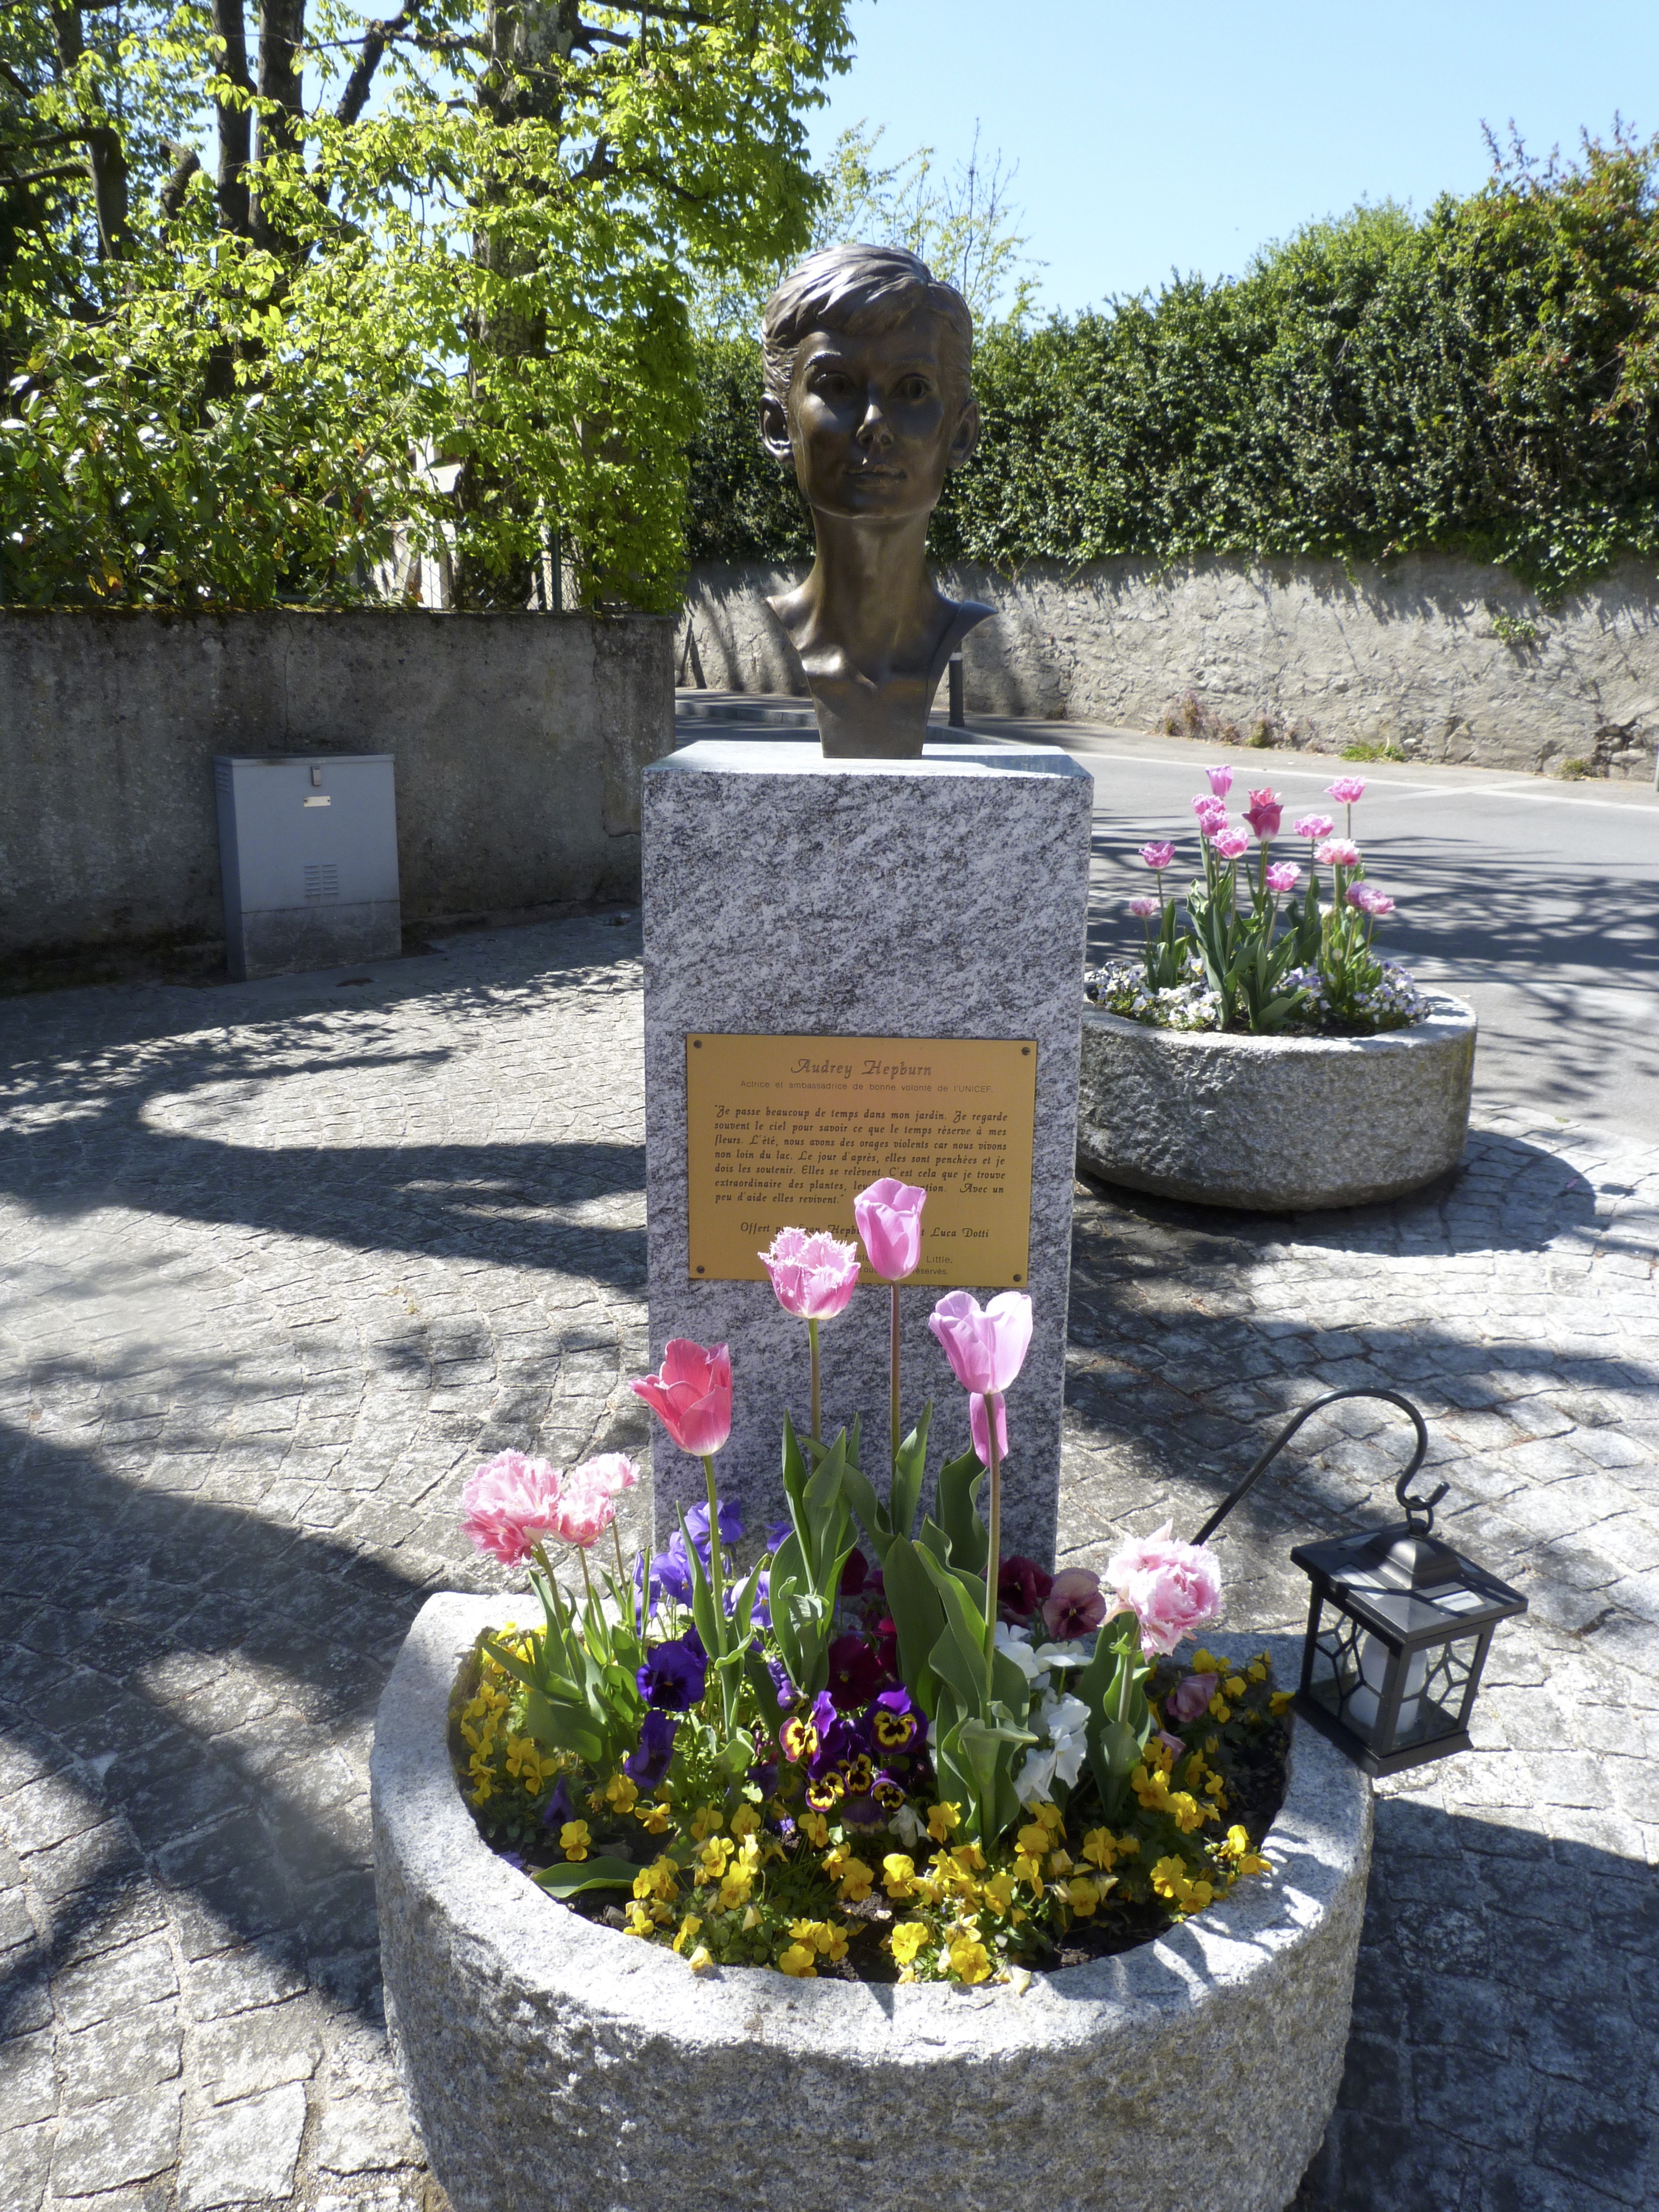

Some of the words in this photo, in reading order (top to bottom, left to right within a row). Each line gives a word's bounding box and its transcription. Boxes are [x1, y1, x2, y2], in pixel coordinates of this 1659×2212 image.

[791, 1059, 852, 1078] Audrey
[862, 1060, 932, 1079] Hepburn
[735, 1108, 760, 1118] passe
[766, 1107, 810, 1119] beaucoup
[815, 1108, 825, 1117] de
[832, 1109, 858, 1120] temps
[864, 1109, 885, 1119] dans
[916, 1111, 947, 1122] jardin.
[953, 1111, 967, 1123] Je
[972, 1112, 1007, 1124] regarde
[714, 1122, 750, 1130] souvent
[756, 1122, 764, 1130] le
[769, 1122, 786, 1131] ciel
[792, 1123, 813, 1134] pour
[868, 1126, 885, 1137] que
[890, 1124, 899, 1133] le
[904, 1126, 932, 1137] temps
[938, 1126, 971, 1135] réserve
[976, 1127, 982, 1135] à
[715, 1135, 743, 1146] fleurs.
[840, 1138, 854, 1147] des
[860, 1140, 888, 1150] orages
[894, 1140, 928, 1148] violents
[737, 1150, 754, 1159] loin
[760, 1151, 771, 1159] du
[777, 1151, 793, 1159] lac.
[798, 1151, 812, 1161] Le
[818, 1152, 837, 1163] jour
[885, 1153, 906, 1162] elles
[911, 1154, 930, 1163] sont
[935, 1154, 977, 1166] penchées
[996, 1156, 1005, 1167] je
[715, 1164, 733, 1173] dois
[739, 1164, 751, 1173] les
[756, 1166, 796, 1174] soutenir.
[801, 1165, 824, 1175] Elles
[844, 1167, 883, 1176] relèvent.
[889, 1167, 912, 1177] C'est
[918, 1168, 937, 1177] cela
[942, 1171, 958, 1180] que
[963, 1170, 972, 1181] je
[977, 1171, 1005, 1179] trouve
[715, 1178, 782, 1187] extraordinaire
[789, 1180, 803, 1188] des
[810, 1181, 847, 1192] plantes,
[854, 1181, 867, 1190] leu
[960, 1183, 987, 1193] Avec
[715, 1195, 732, 1204] peu
[737, 1192, 767, 1202] d'aide
[773, 1194, 794, 1202] elles
[741, 1222, 770, 1235] Offert
[930, 1228, 956, 1237] Luca
[963, 1228, 989, 1238] Dotti
[927, 1256, 953, 1264] Little.
